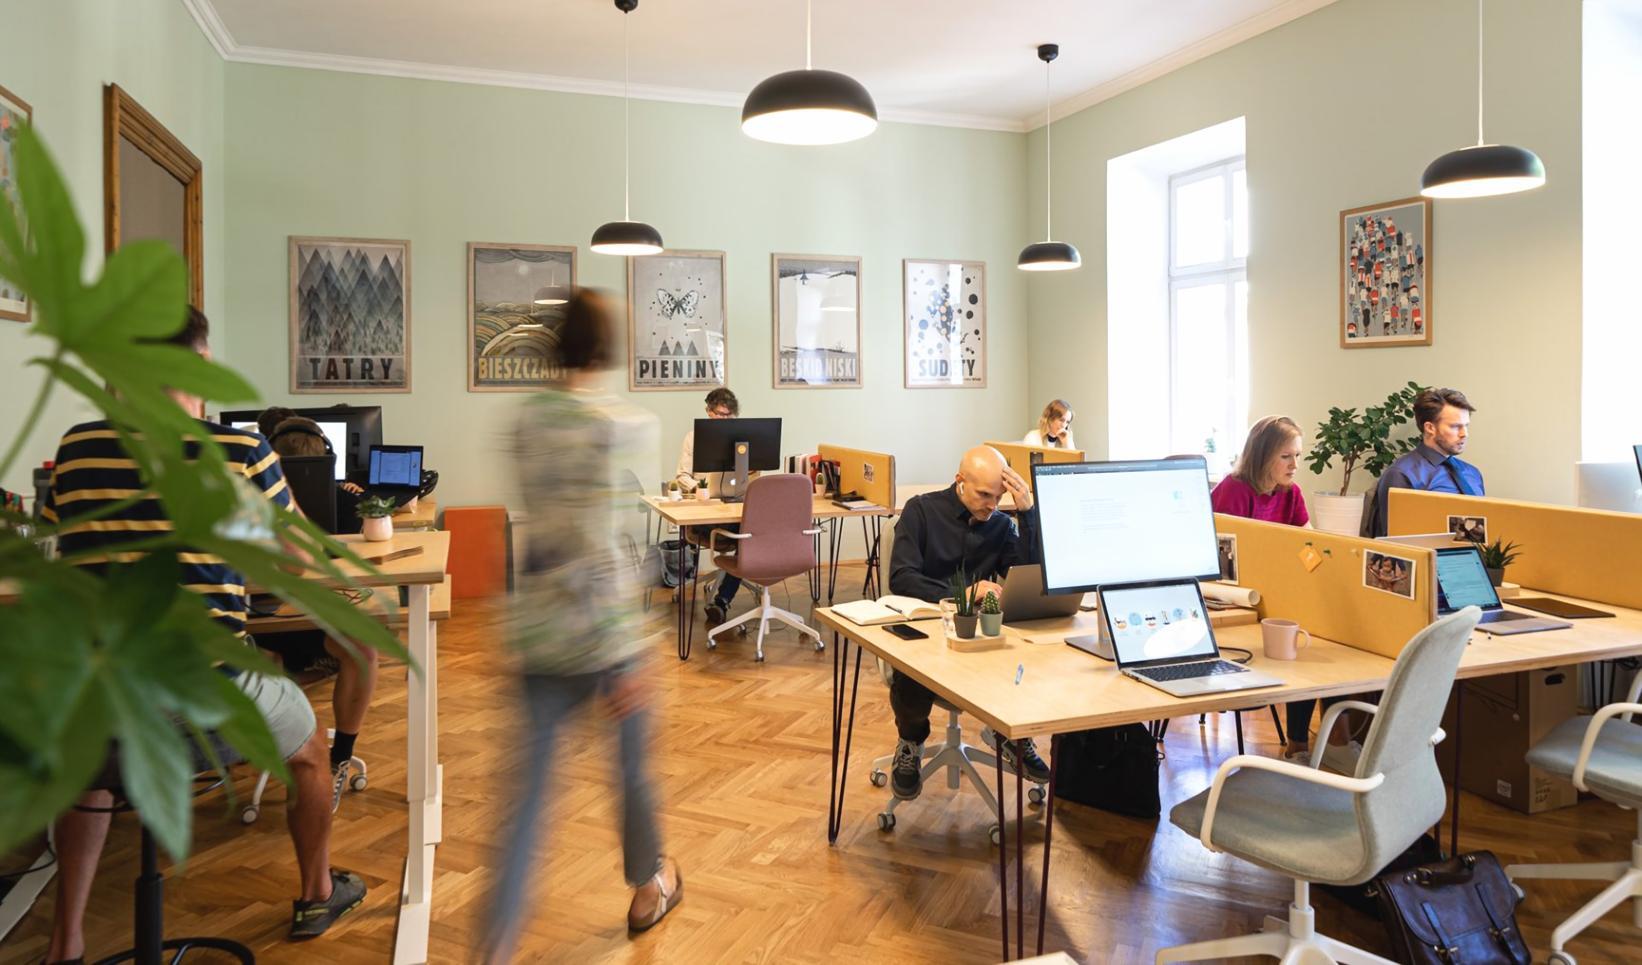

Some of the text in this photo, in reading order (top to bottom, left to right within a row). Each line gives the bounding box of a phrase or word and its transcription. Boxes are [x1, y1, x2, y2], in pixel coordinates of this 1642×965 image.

[309, 358, 393, 380] TATRY
[639, 360, 719, 378] PIENINY
[826, 358, 856, 377] NISKI
[919, 359, 975, 376] SUDTY
